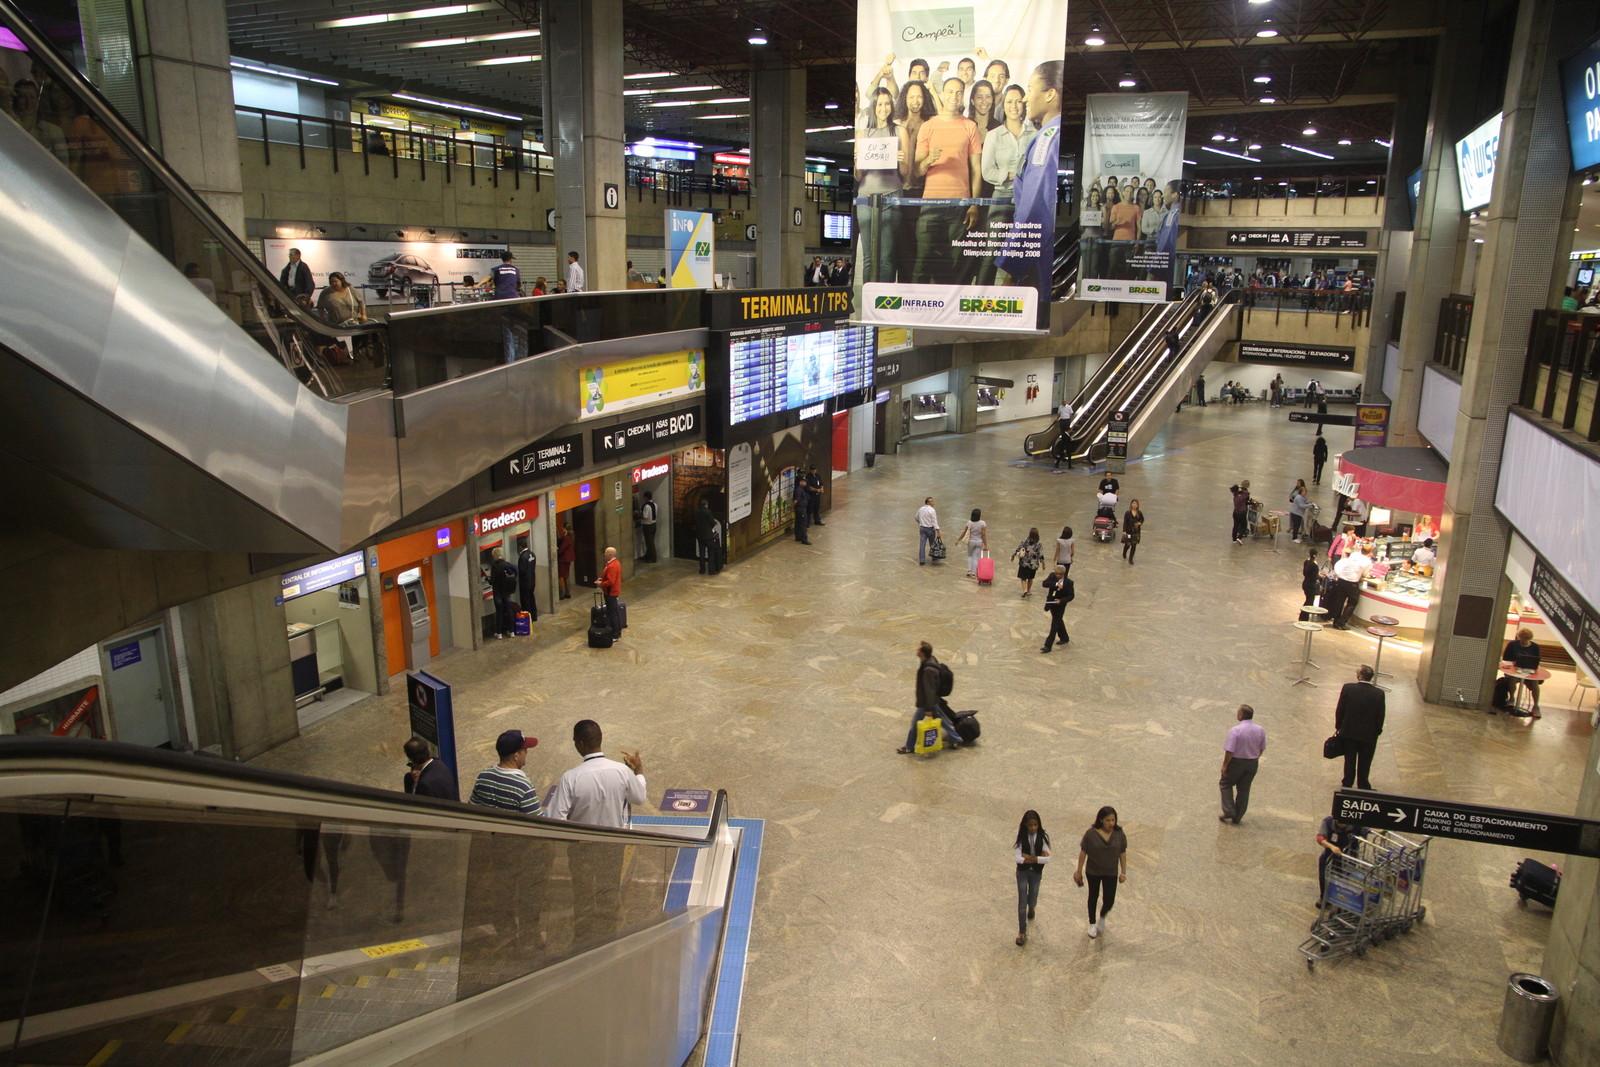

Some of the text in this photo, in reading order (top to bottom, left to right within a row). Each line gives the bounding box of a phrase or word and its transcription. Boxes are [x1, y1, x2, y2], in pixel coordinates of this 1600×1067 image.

[1014, 222, 1042, 230] Quadros
[998, 232, 1027, 240] categoria
[1281, 234, 1290, 242] A
[1022, 242, 1041, 250] Jogos
[1002, 250, 1024, 259] Beijing
[741, 292, 848, 319] TERMINAL 1 / TPS
[902, 300, 944, 308] INFRAERO
[960, 298, 1024, 314] BRASIL
[627, 413, 694, 436] CHECK-IN ASAS B/C/D
[538, 443, 571, 459] TERMINAL 2
[538, 457, 566, 470] TERMINAL 2
[641, 464, 669, 480] Bradesco
[482, 509, 526, 532] Bradesco
[281, 574, 303, 586] CENTRAL
[62, 700, 89, 730] HIDRANTE
[1342, 800, 1380, 812] SAÍDA
[1340, 810, 1364, 819] EXIT
[1424, 810, 1450, 818] CAIXA
[1470, 815, 1548, 831] ESTACIONAMENTO
[1423, 817, 1483, 829] PARKING CASHIER
[1453, 827, 1515, 840] ESTACIONAMIENTO
